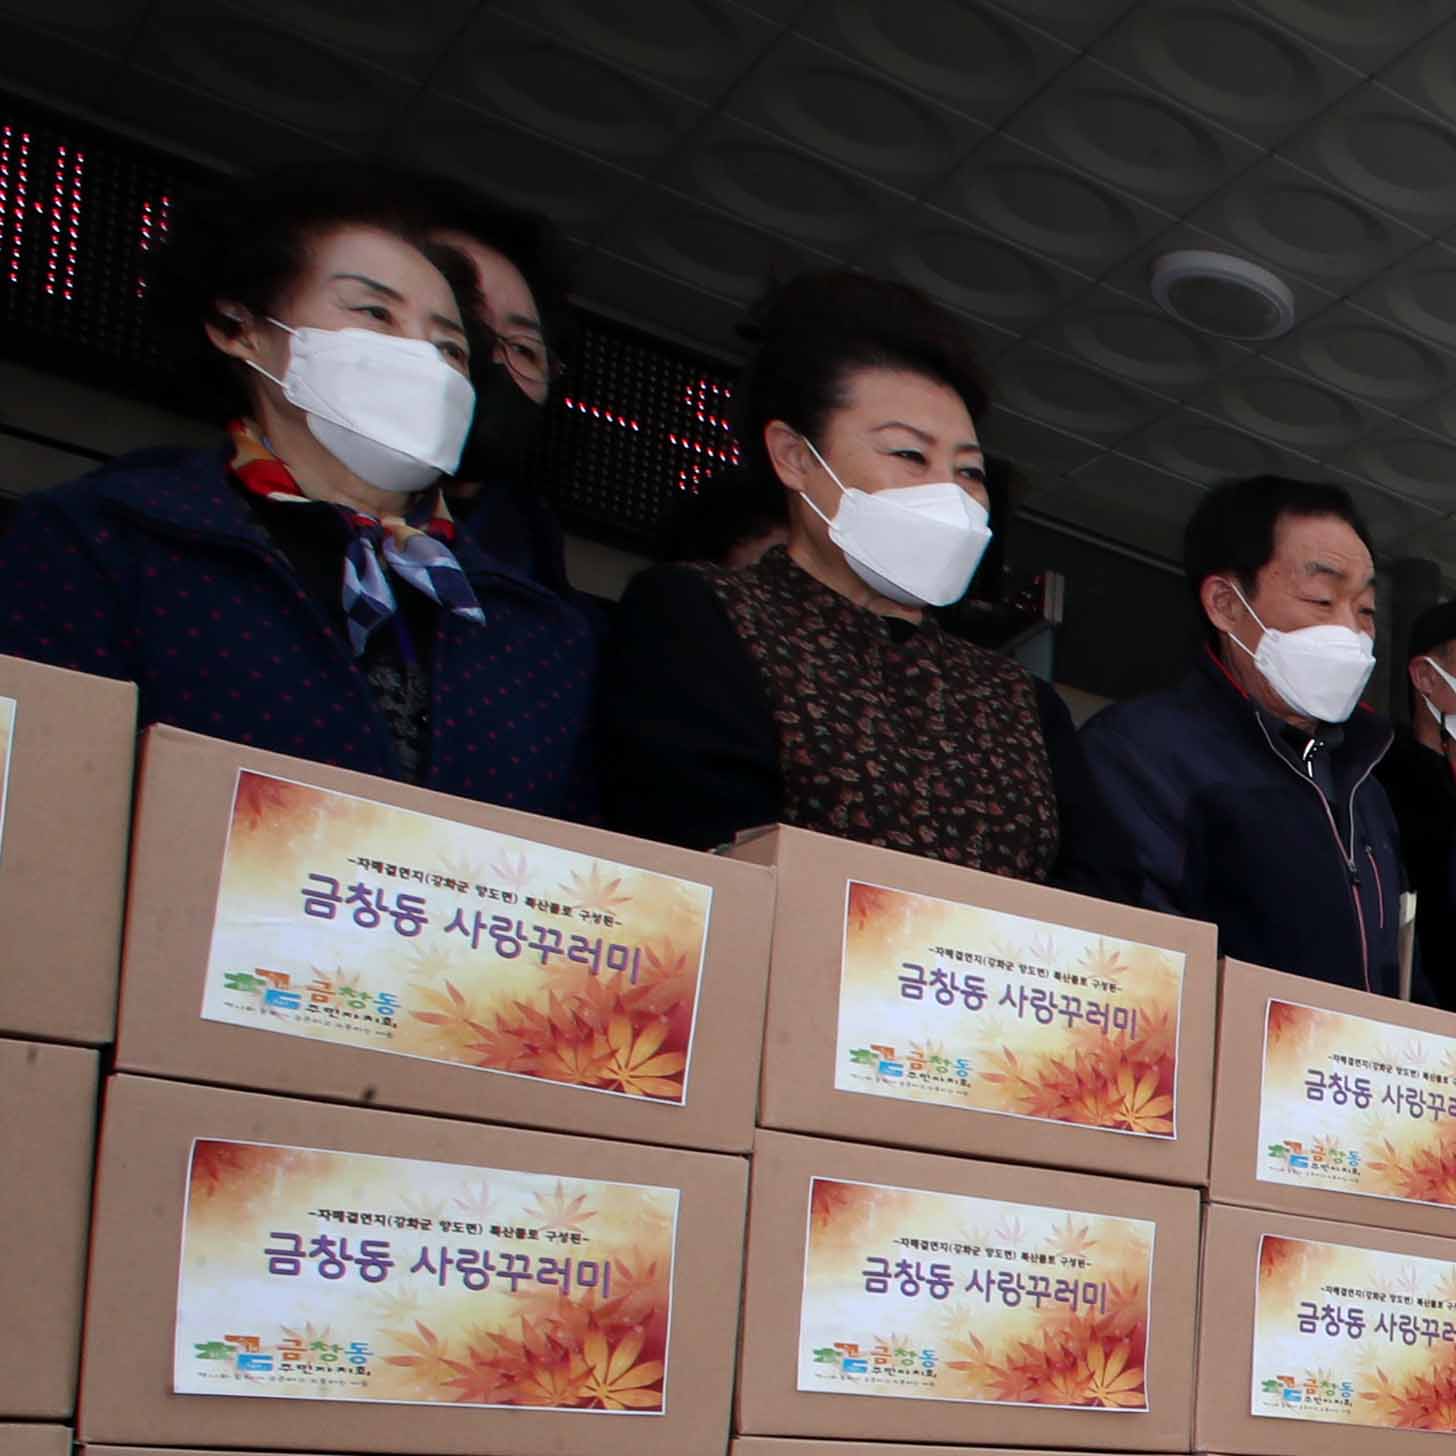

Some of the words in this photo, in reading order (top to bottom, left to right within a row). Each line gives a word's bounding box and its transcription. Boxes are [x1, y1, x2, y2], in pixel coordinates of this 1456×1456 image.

[301, 872, 431, 939] 금창동
[445, 908, 643, 984] 사랑꾸러미
[897, 961, 990, 1013] 금창동
[999, 984, 1139, 1040] 사랑꾸러미
[1304, 1067, 1375, 1111] 금창동
[264, 1231, 396, 1285] 금창동
[411, 1246, 613, 1299] 사랑꾸러미
[861, 1255, 956, 1302] 금창동
[966, 1269, 1109, 1315] 사랑꾸러미
[1297, 1301, 1368, 1342] 금창동
